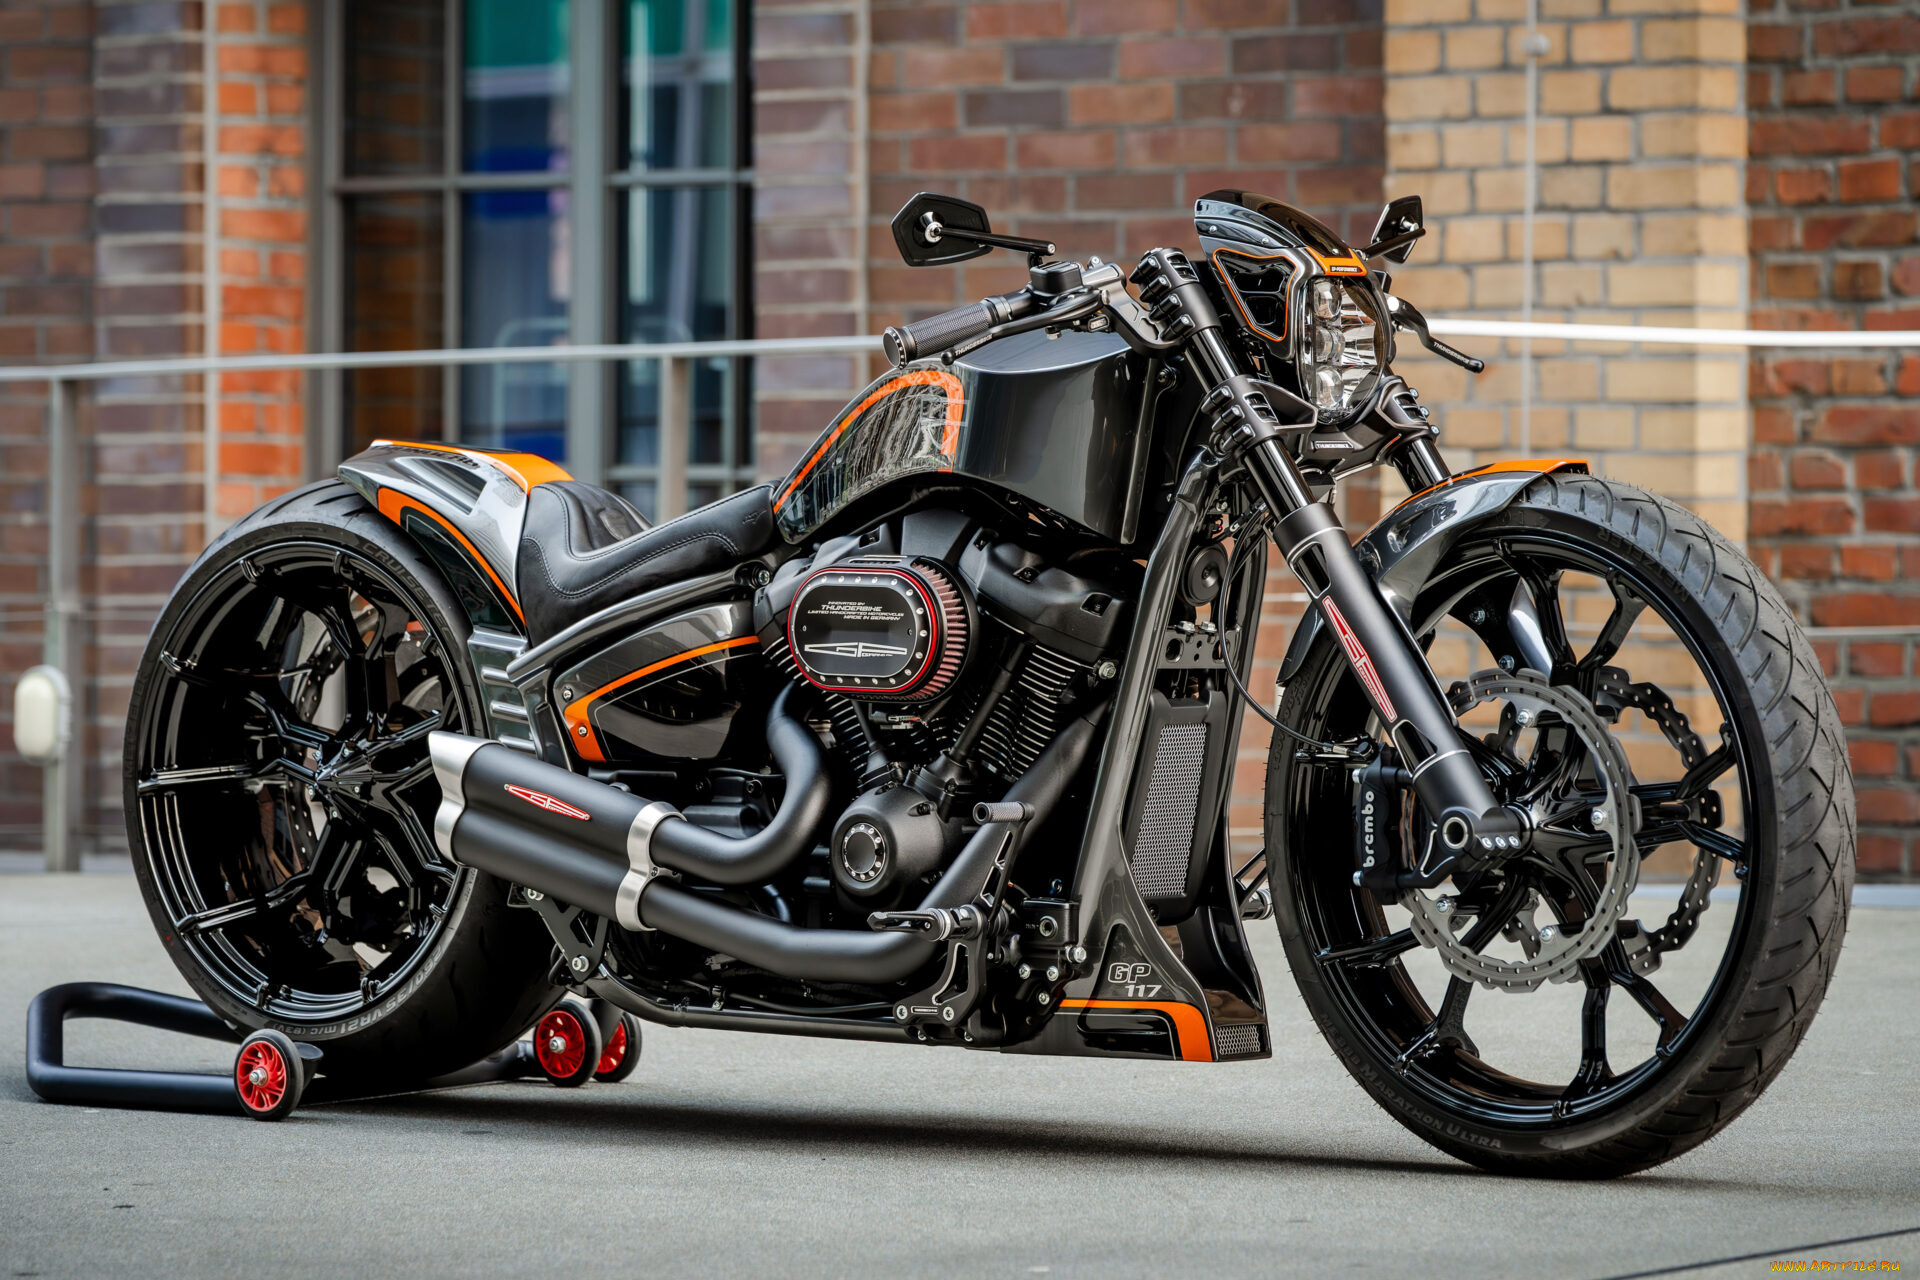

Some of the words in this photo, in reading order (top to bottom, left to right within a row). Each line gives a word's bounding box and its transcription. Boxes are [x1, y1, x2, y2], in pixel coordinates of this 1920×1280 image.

[955, 333, 993, 356] THUNDERBIKE
[1433, 341, 1470, 365] THUNDERBIKE
[362, 543, 457, 644] CRUISETEC
[821, 604, 883, 612] THUNDERBIKE
[1361, 791, 1375, 867] brembo
[385, 944, 443, 1009] 260/35
[1108, 962, 1151, 983] GP
[1125, 984, 1162, 998] 117
[340, 1012, 383, 1034] VR21
[1360, 1063, 1443, 1131] MARATHON
[1445, 1125, 1502, 1149] ULTRA
